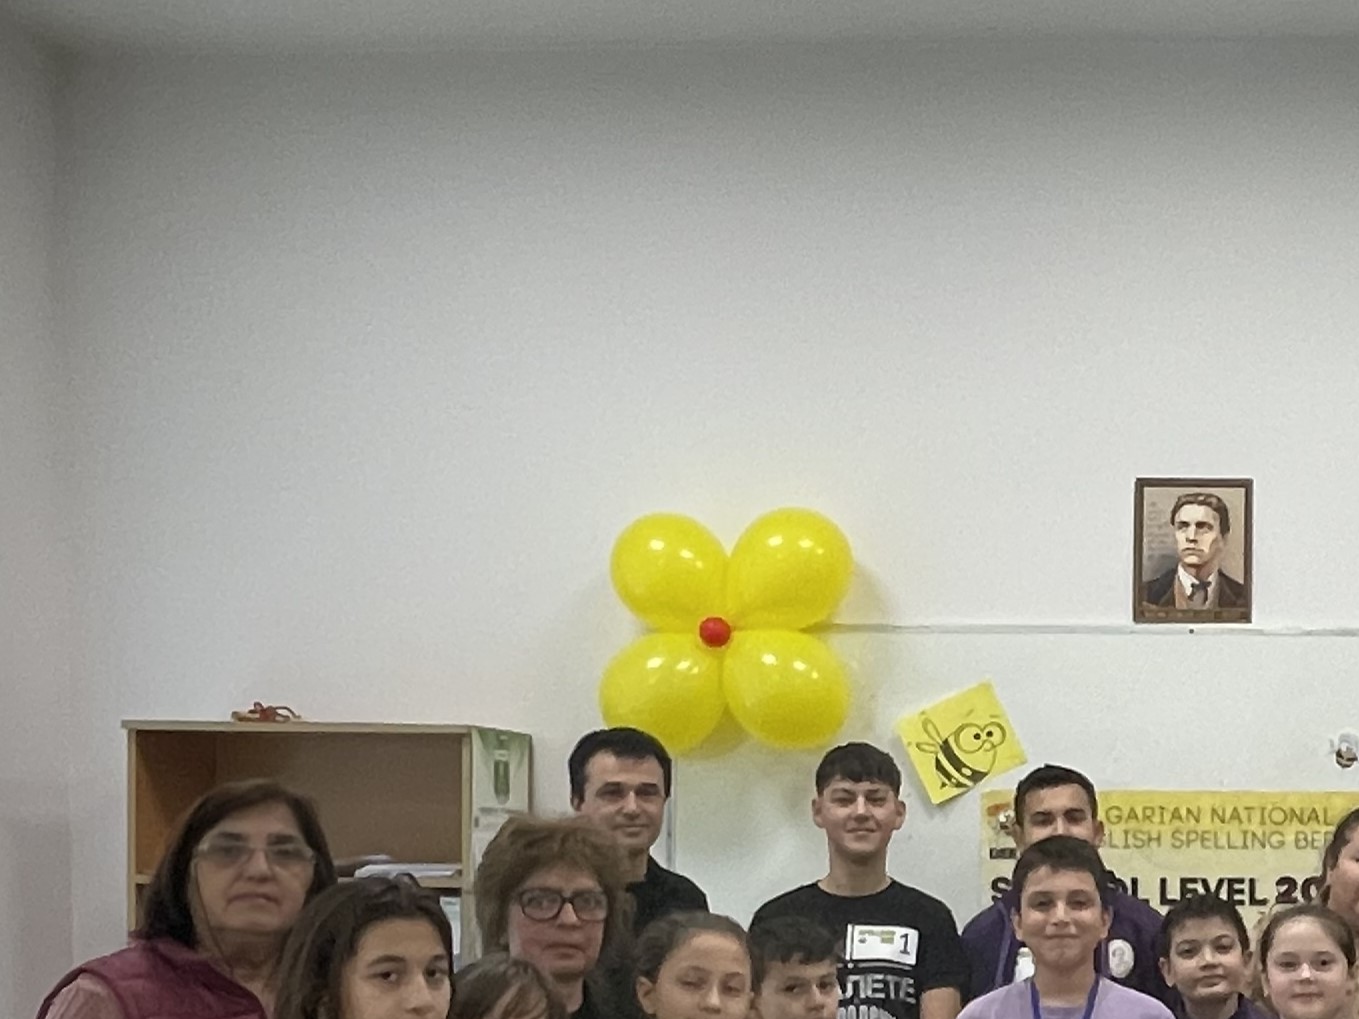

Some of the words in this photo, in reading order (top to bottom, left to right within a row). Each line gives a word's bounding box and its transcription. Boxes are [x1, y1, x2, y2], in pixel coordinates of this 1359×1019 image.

[1105, 805, 1201, 825] GARIAN
[1210, 806, 1334, 826] NATIONAL
[1108, 830, 1161, 850] LISH
[1170, 830, 1285, 850] SPELLING
[1159, 876, 1269, 906] LEVEL
[1275, 875, 1322, 905] 20
[899, 933, 911, 955] 1
[845, 973, 917, 1004] ЛЕТЕ
